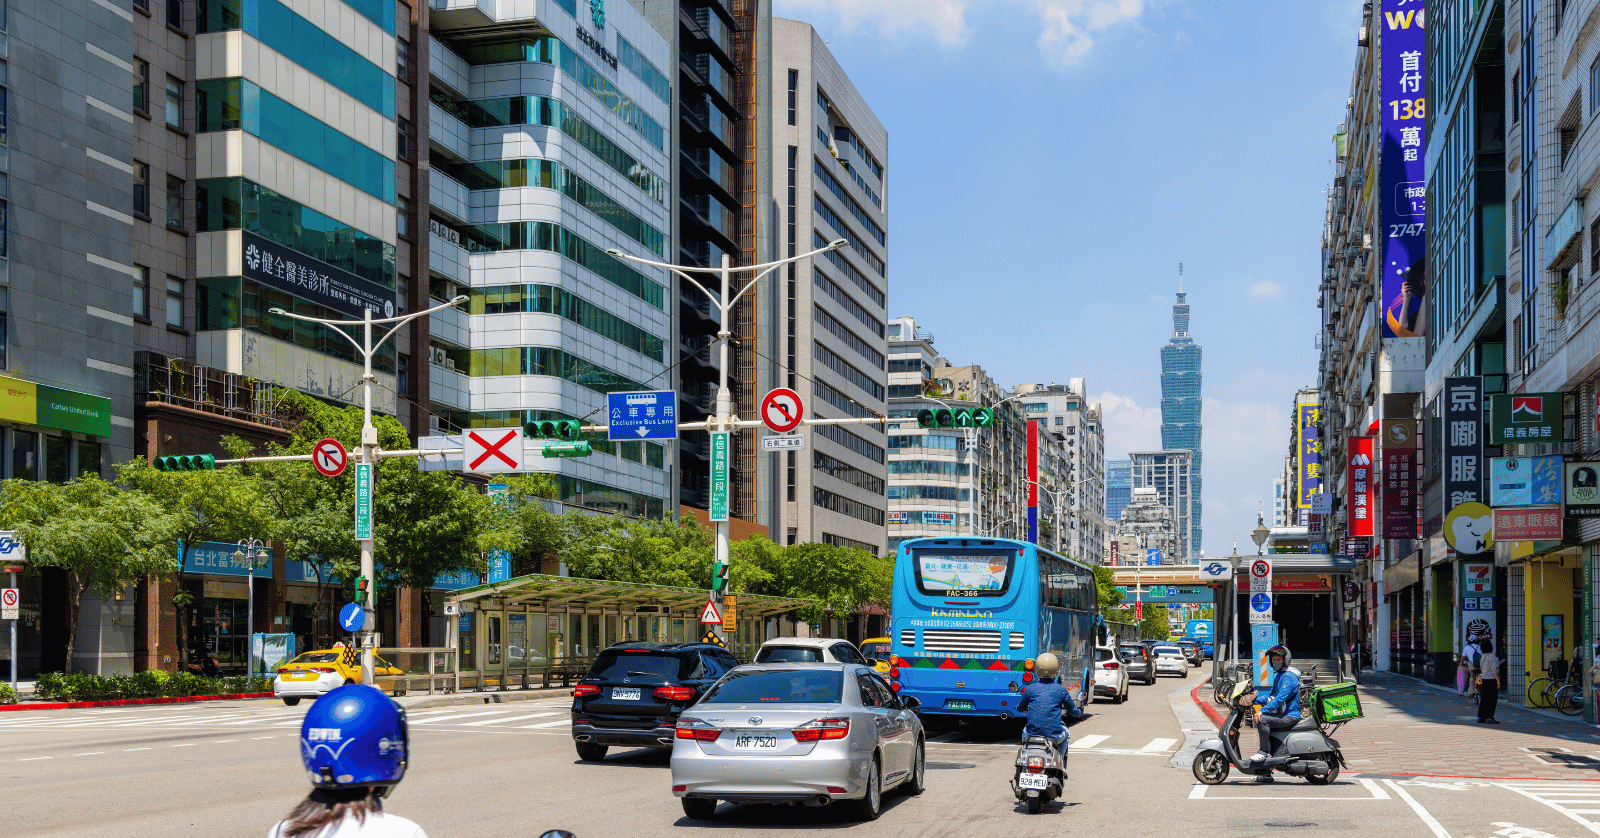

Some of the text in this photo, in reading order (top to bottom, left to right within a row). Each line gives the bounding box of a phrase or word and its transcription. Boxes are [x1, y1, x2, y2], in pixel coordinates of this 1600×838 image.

[1389, 50, 1425, 162] 首付 138 萬起
[262, 250, 329, 297] 健全醫美診所
[611, 405, 674, 418] 公車專用
[1503, 427, 1551, 438] 信義房屋
[716, 440, 725, 492] 信義路三段
[360, 470, 368, 515] 信義路三段
[1354, 468, 1367, 519] 摩斯漢堡
[1497, 513, 1559, 529] 遠東眼鏡
[1320, 578, 1327, 588] 3
[735, 736, 777, 748] ARF-7520
